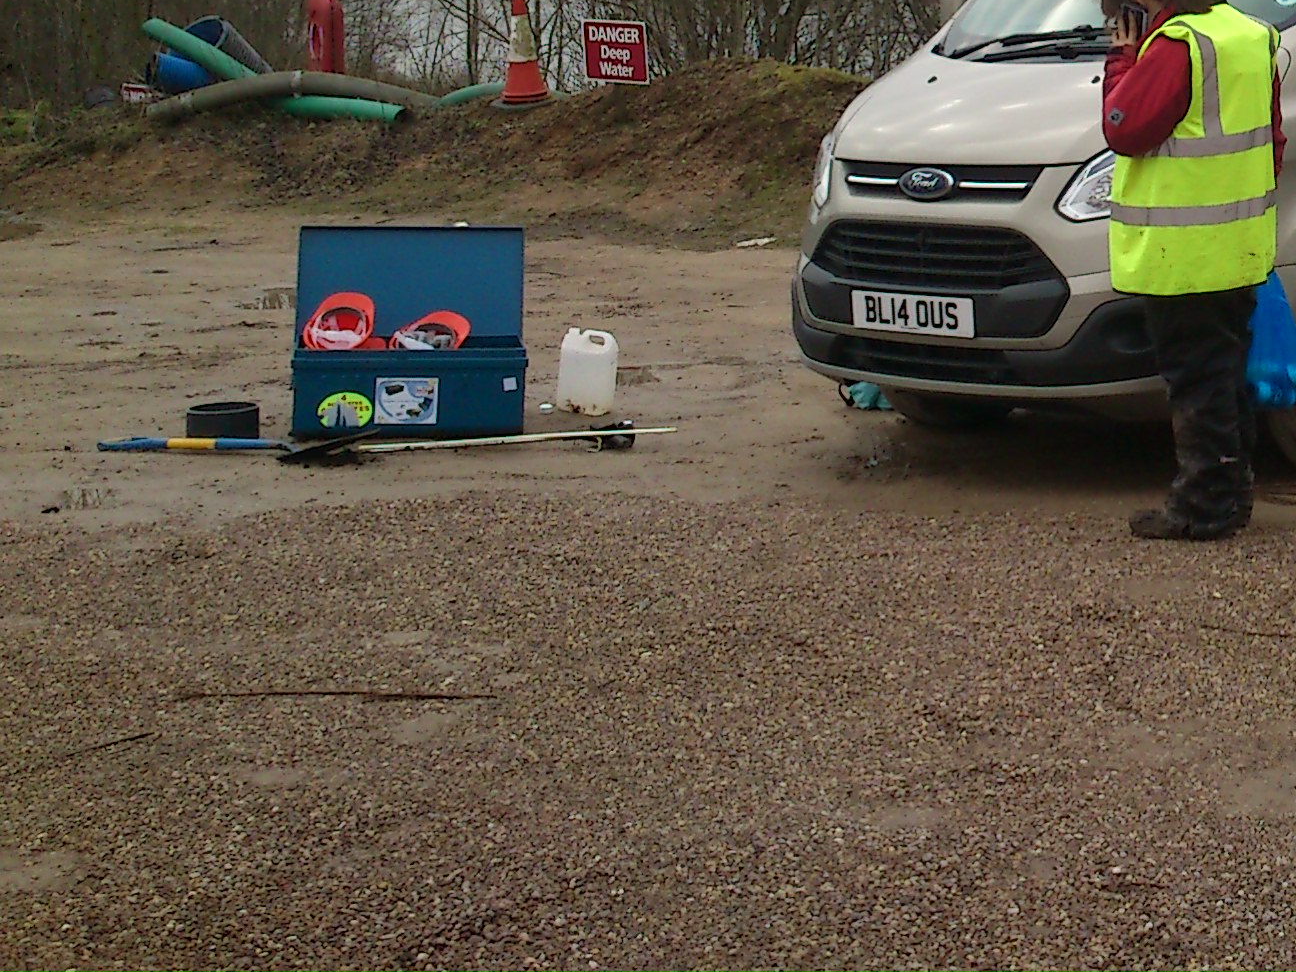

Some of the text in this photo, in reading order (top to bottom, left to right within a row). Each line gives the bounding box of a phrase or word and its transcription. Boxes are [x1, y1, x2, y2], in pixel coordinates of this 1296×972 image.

[588, 26, 640, 44] DANGER
[600, 45, 631, 64] Deep
[599, 61, 634, 78] Water
[911, 171, 940, 189] Ford
[864, 295, 959, 330] BL14 OUS
